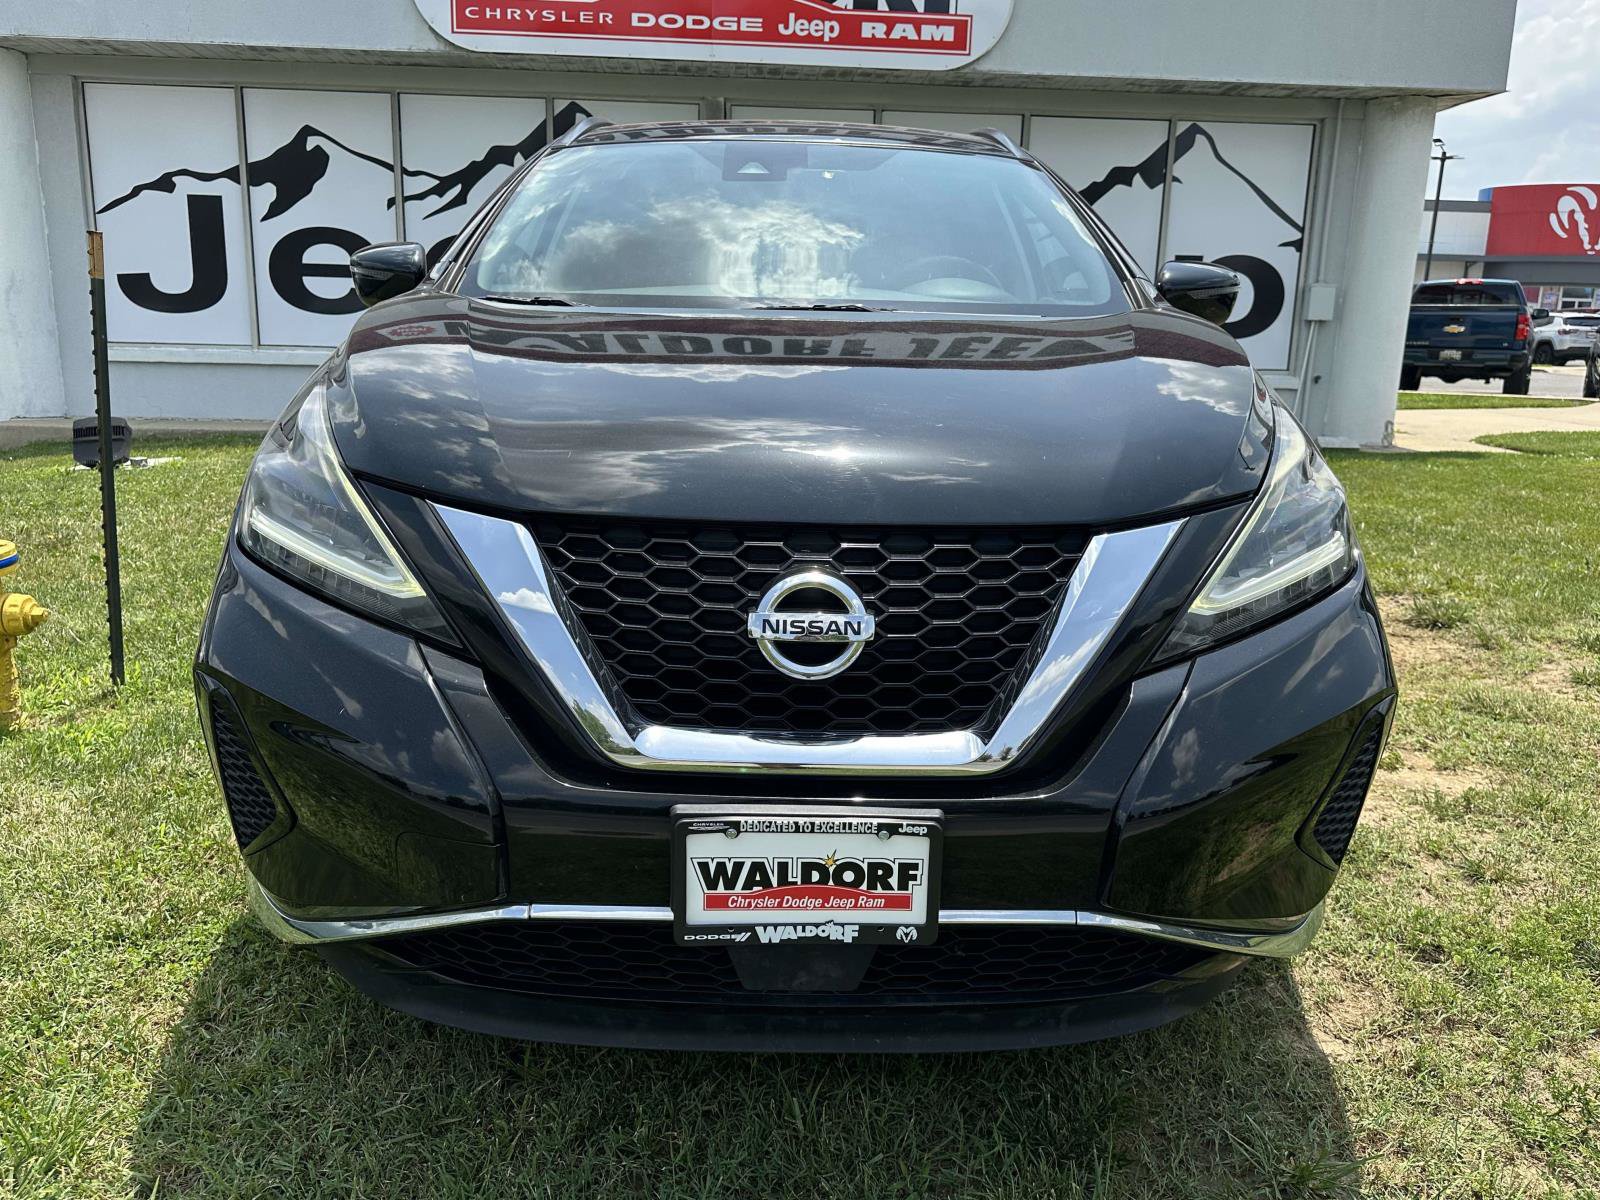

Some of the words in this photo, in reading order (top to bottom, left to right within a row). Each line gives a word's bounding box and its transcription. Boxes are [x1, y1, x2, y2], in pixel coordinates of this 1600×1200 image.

[465, 7, 613, 24] CHRYSLER
[631, 12, 763, 32] DODGE
[778, 12, 840, 42] Jeep
[861, 21, 955, 42] RAM
[761, 618, 862, 637] NISSAN
[740, 820, 796, 832] DEDICATED
[797, 821, 812, 833] TO
[813, 821, 878, 834] EXCELLENCE
[898, 822, 928, 836] Jeep
[692, 858, 922, 893] WALDORF
[727, 895, 780, 909] Chrysler
[782, 896, 823, 910] Dodge
[824, 897, 856, 911] Jeep
[857, 897, 885, 909] Ram
[755, 923, 860, 944] WALDORF
